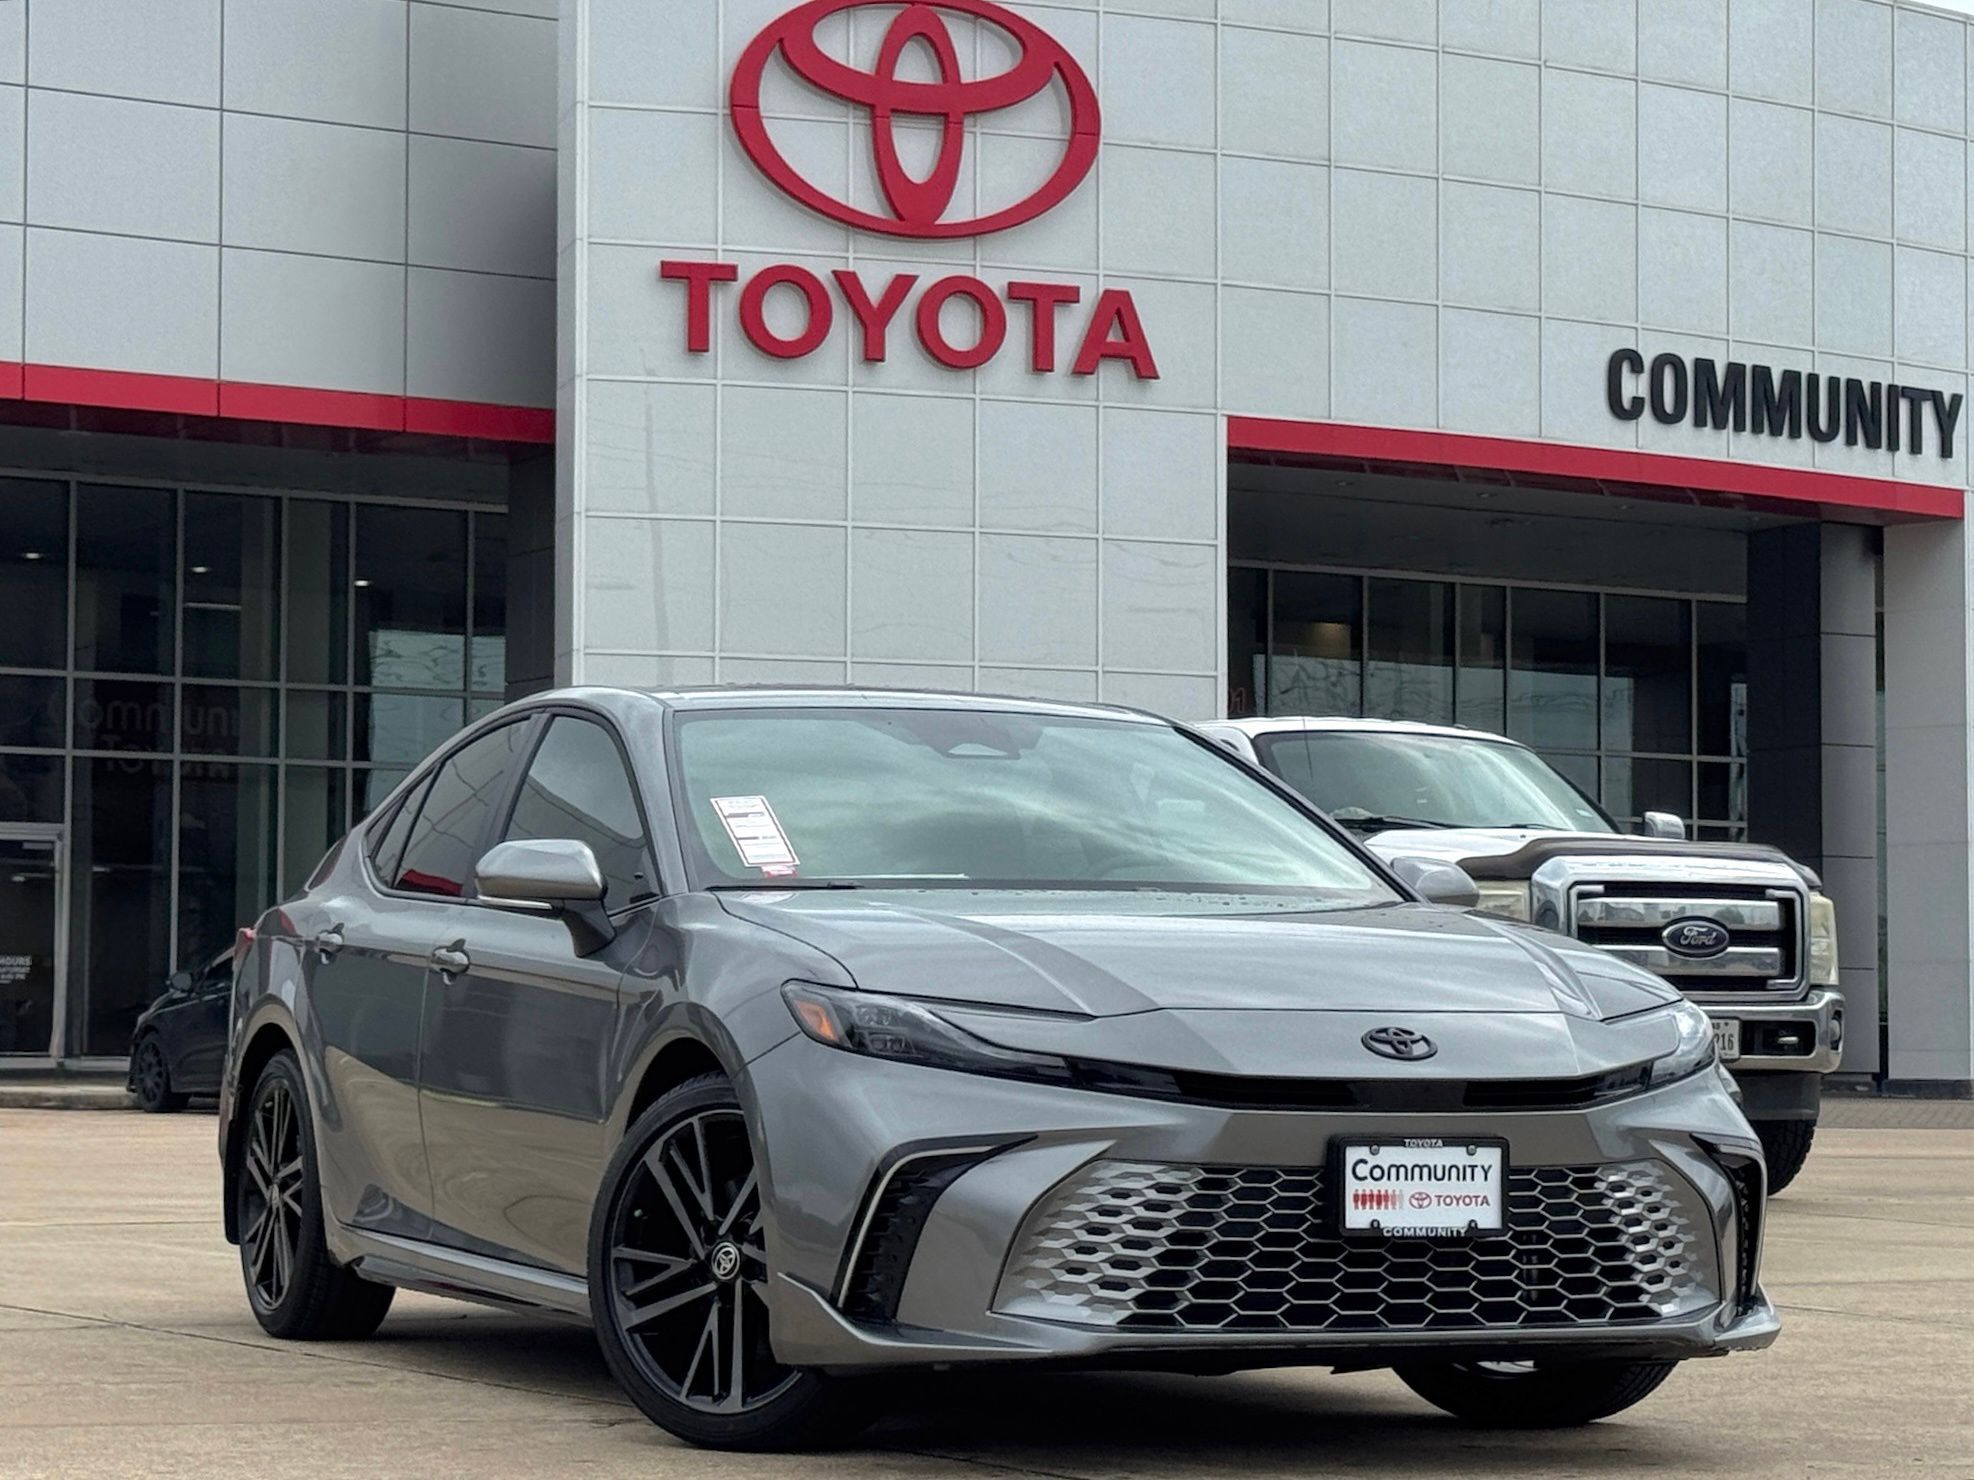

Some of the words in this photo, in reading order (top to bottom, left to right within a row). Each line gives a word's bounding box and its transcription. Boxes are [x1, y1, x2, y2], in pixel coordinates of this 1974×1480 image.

[660, 260, 1160, 381] TOYOTA
[1607, 348, 1964, 459] COMMUNITY
[1680, 925, 1717, 946] Ford
[1403, 1138, 1444, 1148] TOYOTA
[1434, 1194, 1491, 1207] TOYOTA
[1383, 1226, 1467, 1237] COMMUNITY
